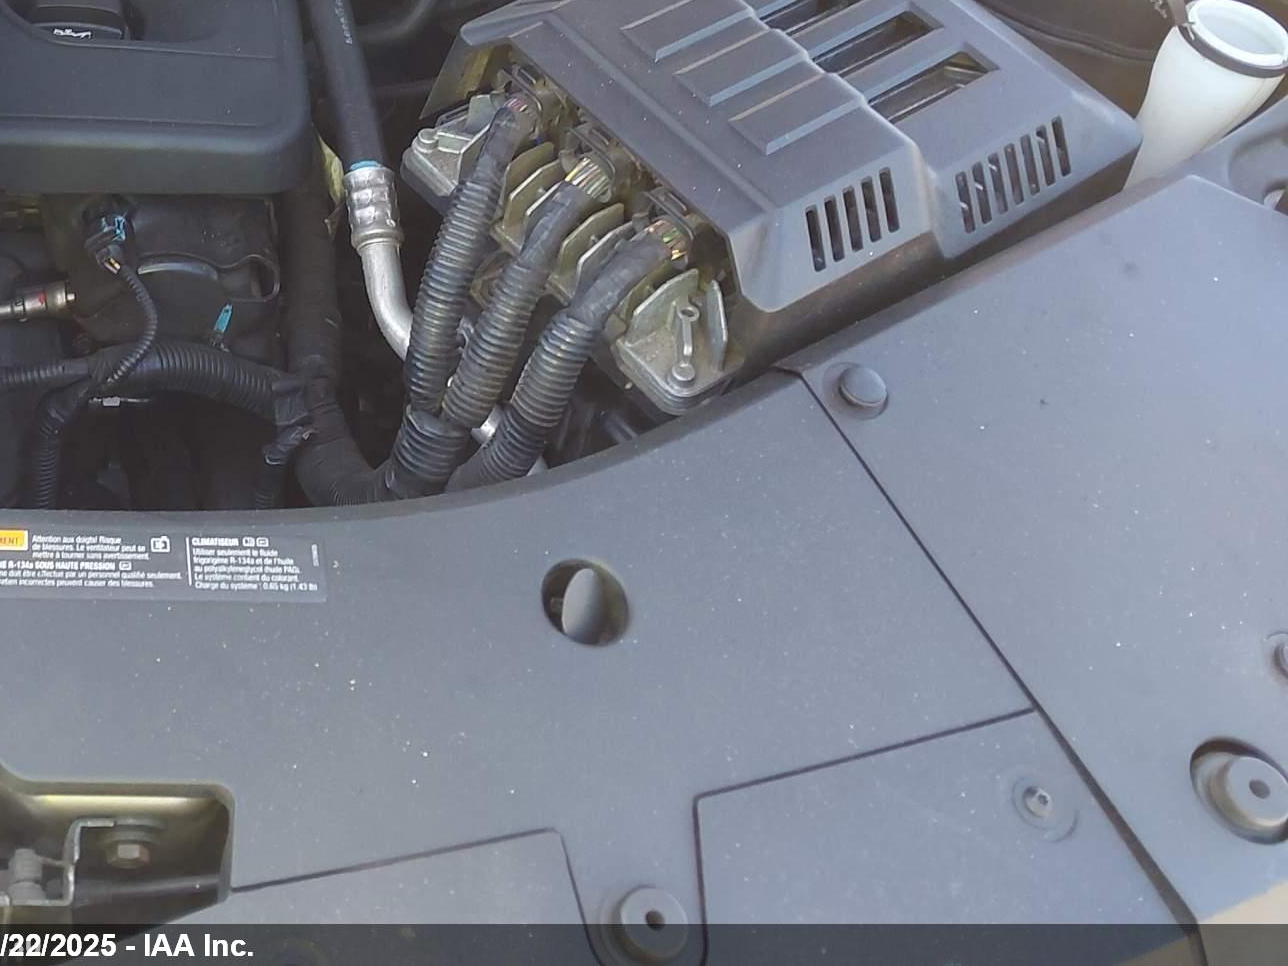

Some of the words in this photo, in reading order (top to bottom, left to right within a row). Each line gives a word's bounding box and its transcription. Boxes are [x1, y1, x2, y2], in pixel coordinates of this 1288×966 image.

[32, 535, 62, 543] Attention
[99, 536, 122, 545] Risque
[192, 537, 239, 546] CLIMATISEUR
[121, 545, 136, 553] peut
[192, 548, 216, 556] Utiliser
[259, 549, 278, 557] fluide
[7, 560, 34, 570] R-134a
[34, 561, 55, 570] SOUS
[55, 561, 79, 571] HAUTE
[79, 561, 115, 571] PRESSION
[229, 557, 255, 565] R-134a
[64, 571, 77, 579] par
[87, 571, 121, 579] personnel
[261, 574, 271, 582] du
[18, 578, 56, 586] incorrectes
[56, 579, 83, 588] peuvent
[195, 581, 219, 590] Charge
[219, 582, 230, 590] du
[279, 583, 289, 592] kg
